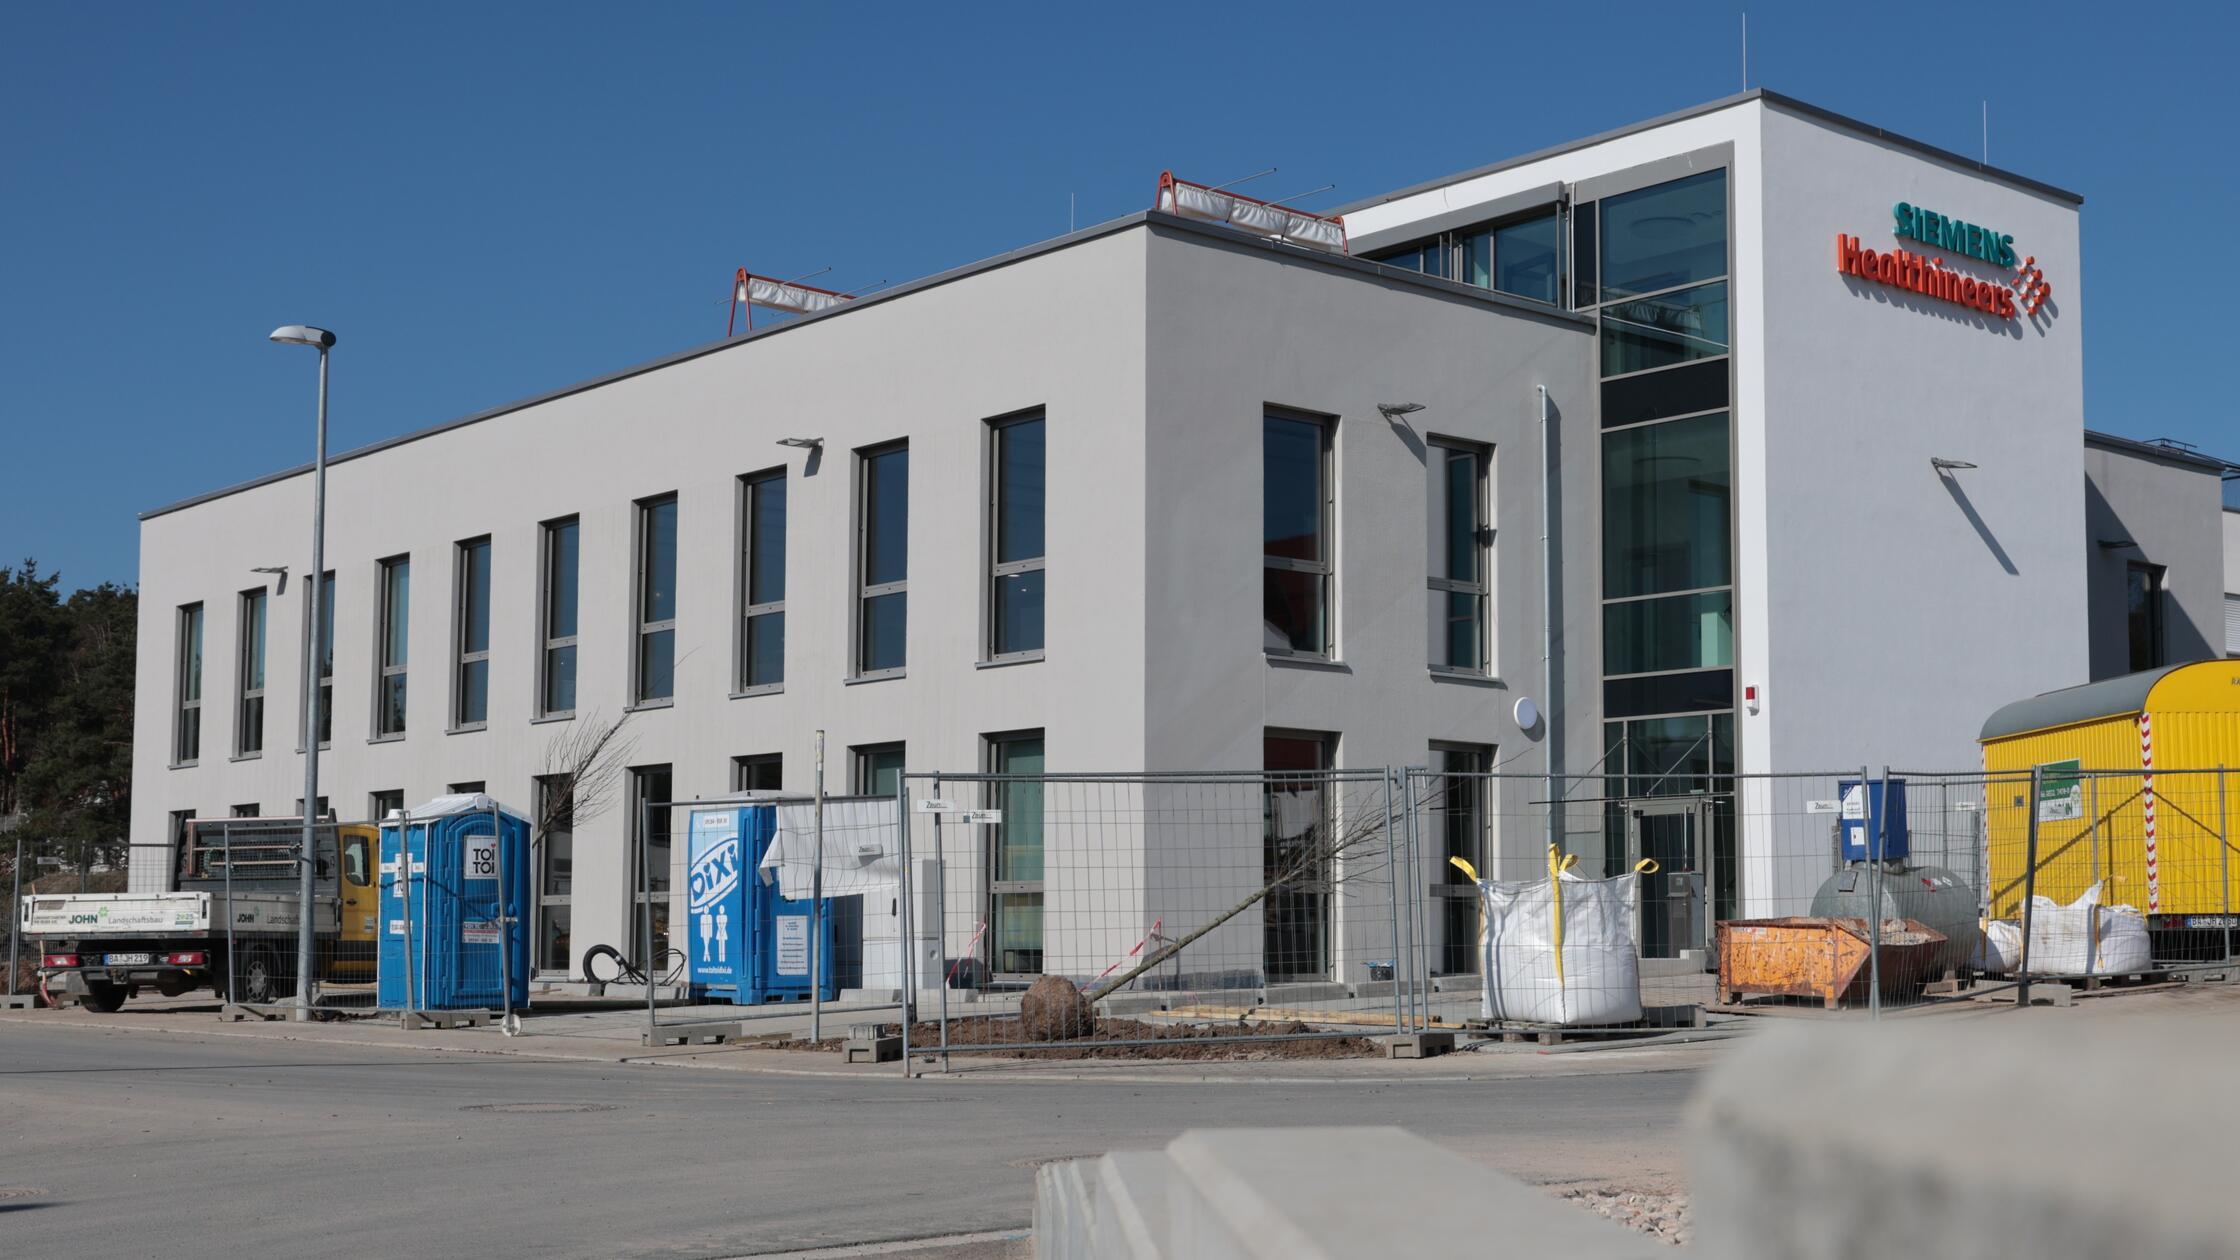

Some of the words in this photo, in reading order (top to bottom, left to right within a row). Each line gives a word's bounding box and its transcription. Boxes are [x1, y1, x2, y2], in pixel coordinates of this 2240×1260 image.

[1893, 202, 2015, 268] SIEMENS
[1837, 233, 2016, 320] Healthineers
[68, 914, 98, 925] JOHN
[108, 916, 163, 926] Landschaftsbau
[237, 913, 255, 923] JOHN
[134, 953, 149, 963] 219
